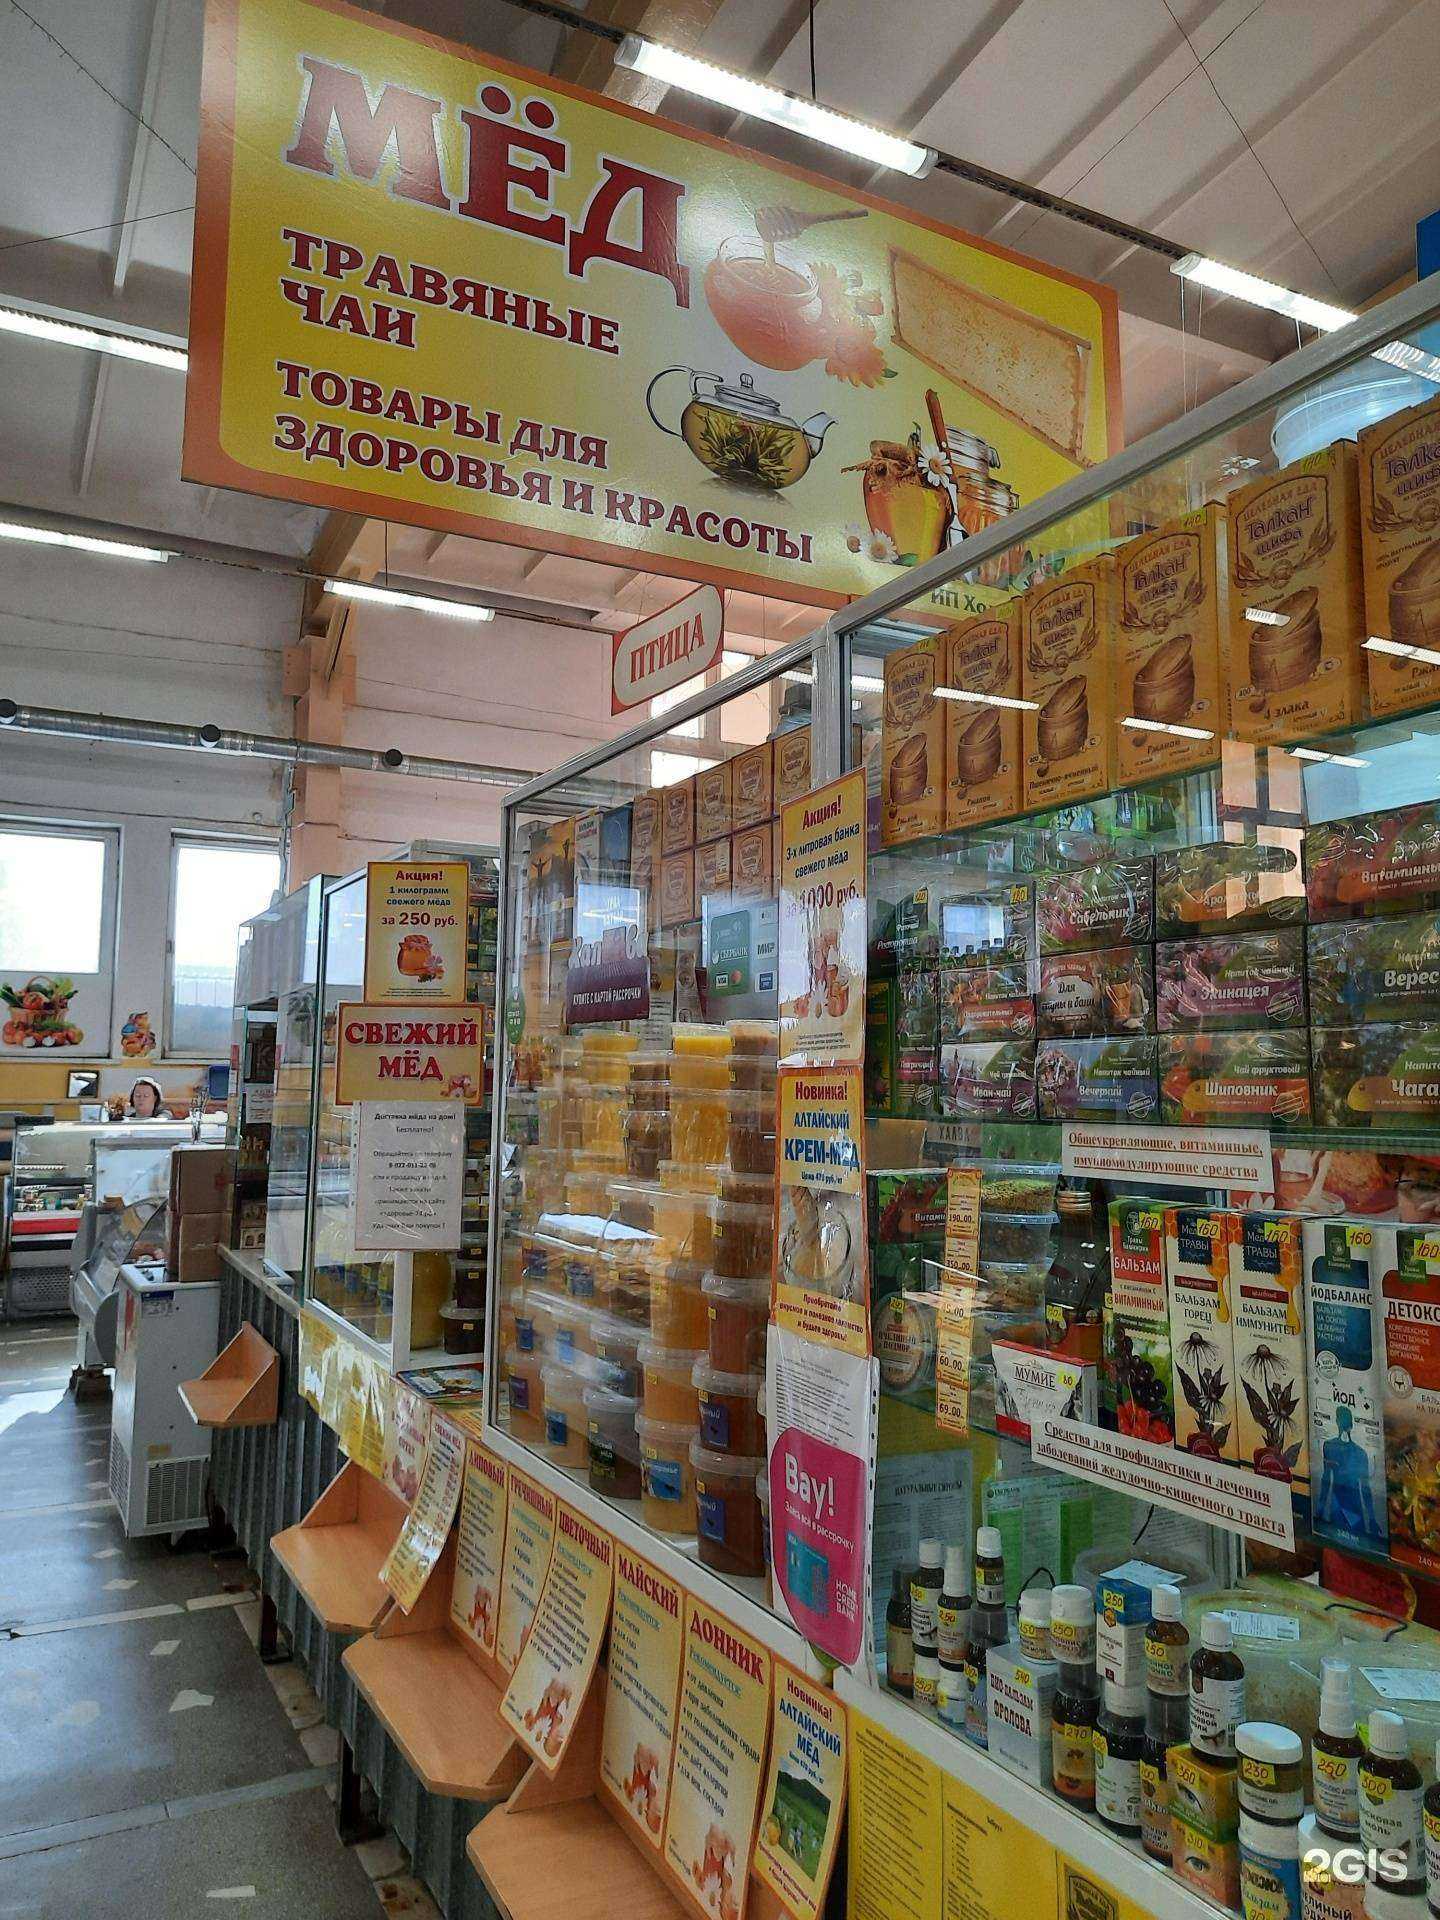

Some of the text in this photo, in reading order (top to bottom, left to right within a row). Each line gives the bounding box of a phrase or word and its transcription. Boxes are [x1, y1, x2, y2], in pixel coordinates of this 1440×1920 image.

[287, 57, 690, 308] МЁД
[283, 229, 619, 354] ТРАВЯНЫЕ
[281, 279, 415, 348] ЧАИ
[277, 361, 607, 469] ТОВАРЫ ДЛЯ
[274, 415, 812, 563] ЗДОРОВЬЯ И КРАСОТЫ
[930, 589, 960, 608] ИП
[630, 613, 705, 683] ПТИЦА
[802, 794, 842, 831] Акция!
[786, 821, 861, 861] 3-х литровая банка
[795, 850, 849, 880] свежего мёда
[395, 870, 443, 882] Акция!
[389, 886, 449, 897] 1 килограмм
[837, 879, 860, 908] руб.
[381, 912, 459, 931] за 250 руб.
[757, 942, 776, 955] МИР
[1057, 981, 1076, 995] Для
[1201, 984, 1270, 1001] Эхинацея
[345, 1017, 478, 1047] СВЕЖИЙ
[378, 1049, 444, 1082] МЁД
[795, 1081, 848, 1101] Новинка!
[973, 1085, 1012, 1099] Иван-чай
[1079, 1084, 1123, 1098] Вечерний
[1204, 1081, 1279, 1098] Шиповник
[794, 1107, 850, 1130] АЛТАЙСКИЙ
[1180, 1139, 1263, 1156] витаминные,
[1202, 1163, 1258, 1178] средства
[1140, 1215, 1159, 1230] 160
[1199, 1223, 1219, 1237] 160
[1181, 1238, 1210, 1251] ТРАВЫ
[1266, 1229, 1289, 1243] 160
[1350, 1231, 1372, 1246] 160
[1114, 1256, 1161, 1276] БАЛЬЗАМ
[1114, 1293, 1165, 1313] ВИТАМИННЫЙ
[1175, 1292, 1221, 1310] БАЛЬЗАМ
[1311, 1286, 1373, 1306] ЙОДБАЛАНС
[1184, 1308, 1213, 1324] ГОРЕЦ
[1242, 1303, 1287, 1320] БАЛЬЗАМ
[1388, 1301, 1440, 1322] ДЕТОКС
[1236, 1316, 1296, 1336] ИММУНИТЕТ
[1015, 1365, 1056, 1388] МУМИЕ
[1062, 1374, 1074, 1386] 80
[1333, 1388, 1356, 1407] ЙОД
[469, 1450, 505, 1488] ЛИПОВЫЙ
[1044, 1420, 1271, 1505] Средства для профилактики и лечения
[511, 1474, 553, 1522] ГРЕЧИШНЫЙ
[1037, 1442, 1099, 1472] заболеваний
[1101, 1462, 1235, 1518] желудочно-кишечного
[1240, 1509, 1286, 1535] тракта
[559, 1510, 611, 1567] ЦВЕТОЧНЫЙ
[818, 1525, 855, 1555] рассрочку
[618, 1553, 679, 1619] МАЙСКИЙ
[836, 1579, 857, 1601] HOME
[836, 1603, 856, 1623] BANK
[690, 1609, 765, 1686] ДОННИК
[787, 1677, 834, 1723] Новинка!
[779, 1698, 841, 1757] АЛТАЙСКИЙ
[994, 1702, 1033, 1737] ФРОЛОВА
[739, 1735, 761, 1764] сердца
[796, 1731, 820, 1769] МЁД
